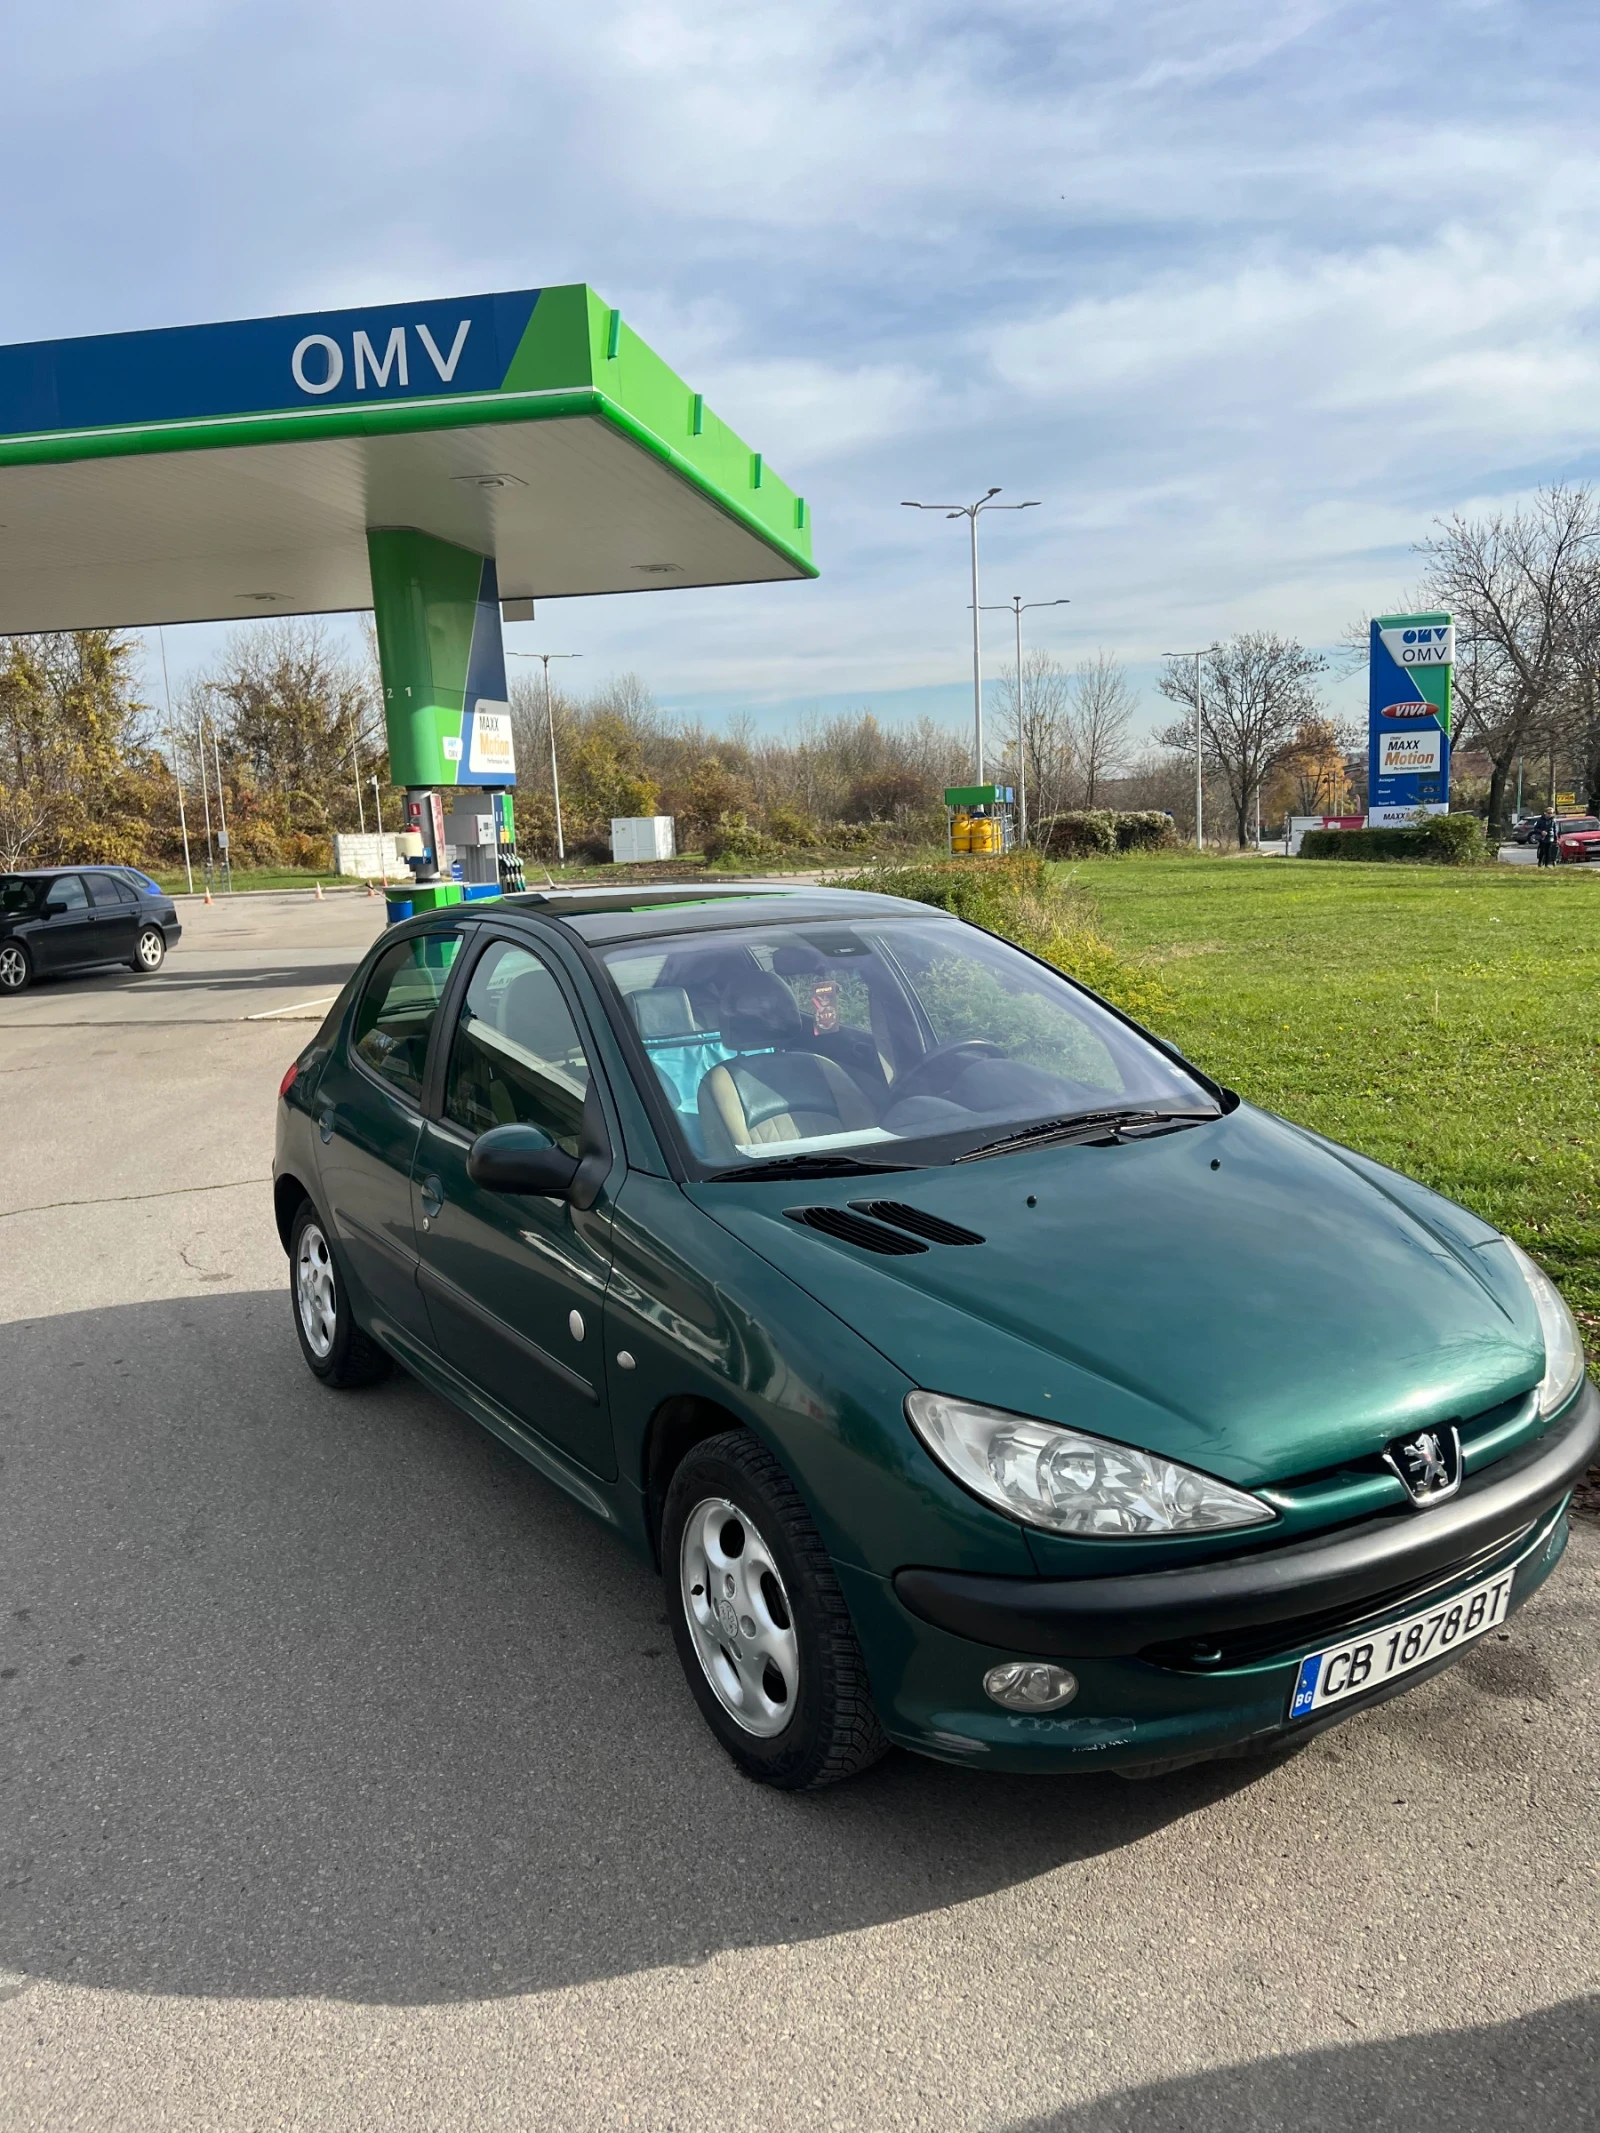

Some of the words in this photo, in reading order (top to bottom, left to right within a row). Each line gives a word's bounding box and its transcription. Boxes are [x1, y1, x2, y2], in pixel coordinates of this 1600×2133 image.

[291, 319, 472, 395] OMV
[1402, 646, 1448, 663] OMV
[386, 687, 394, 699] 2
[404, 686, 412, 697] 1
[1395, 704, 1428, 717] VIVA
[479, 715, 500, 732] MAXX
[480, 732, 510, 756] Motion
[1387, 739, 1421, 751] MAXX
[1384, 751, 1435, 766] Motion
[1295, 1690, 1313, 1708] BG
